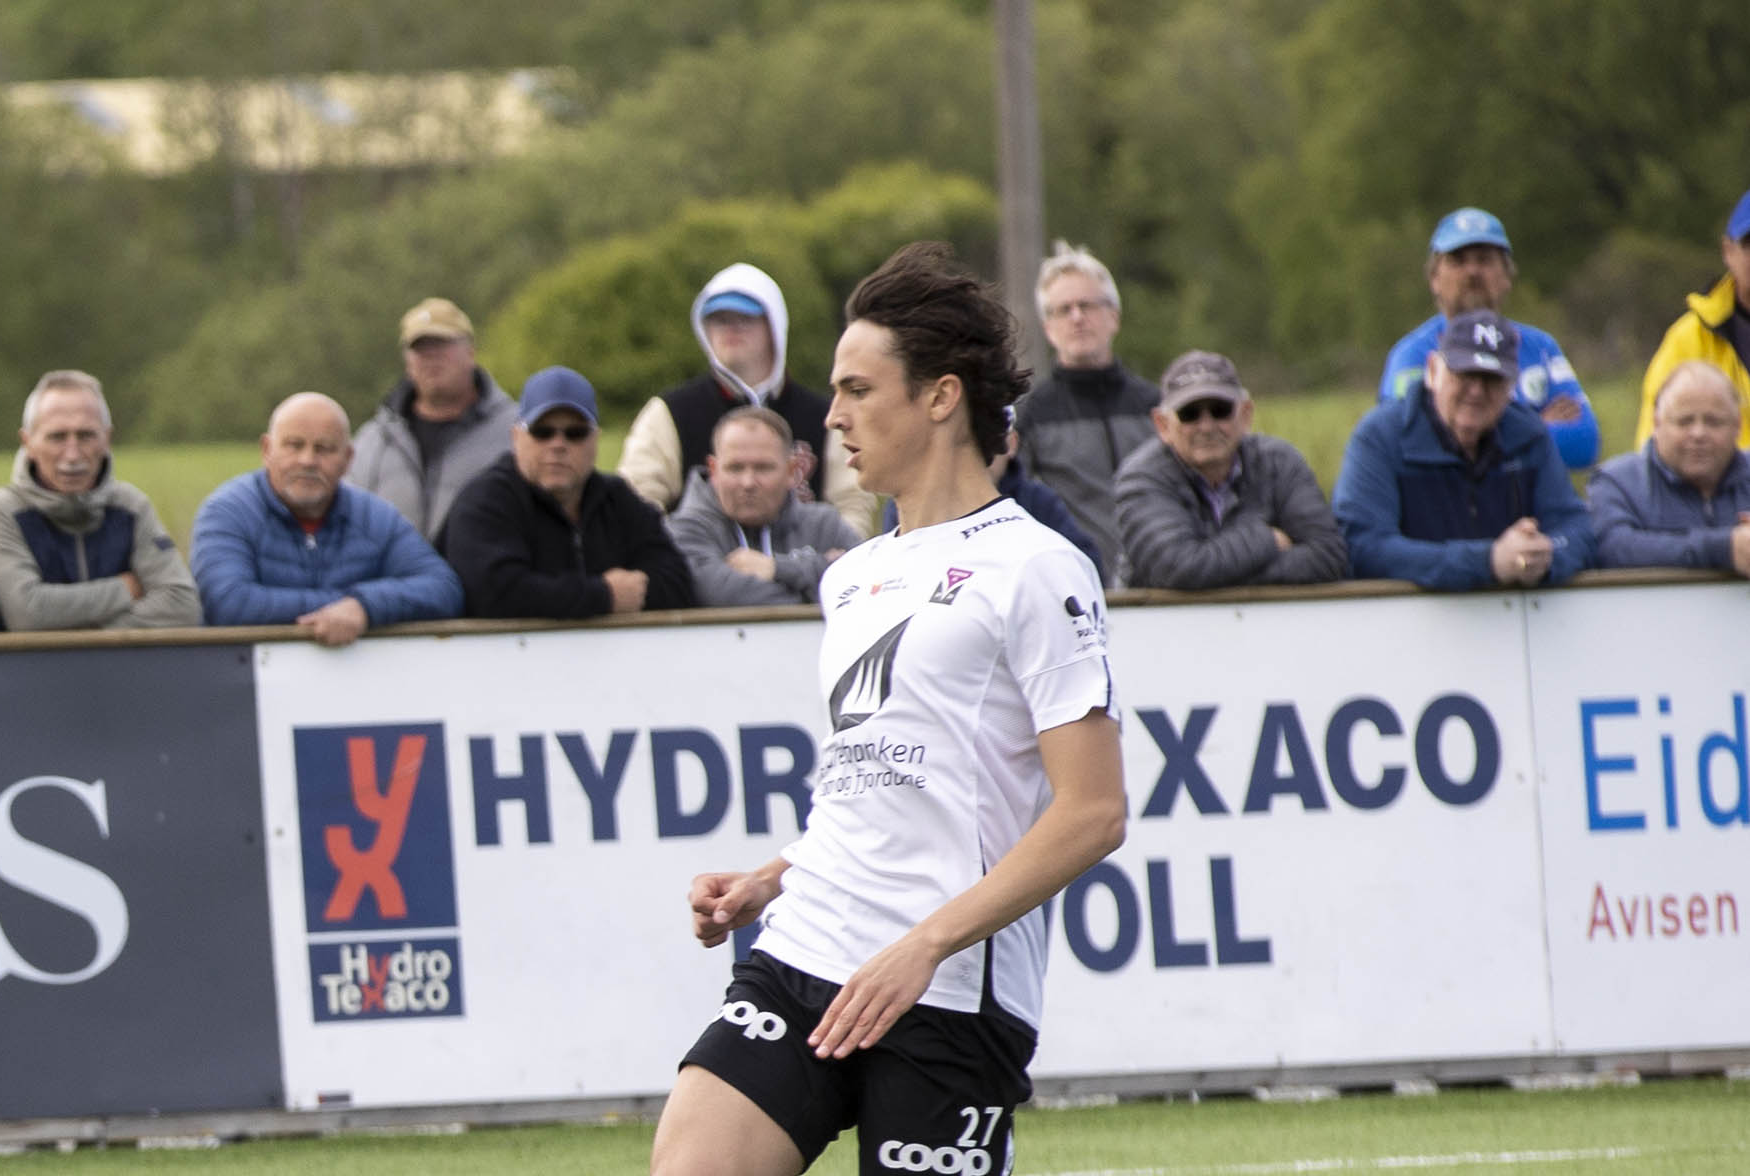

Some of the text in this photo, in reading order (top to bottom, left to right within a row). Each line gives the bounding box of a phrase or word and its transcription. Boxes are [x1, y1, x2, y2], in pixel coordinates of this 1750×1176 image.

[469, 723, 815, 847] HYDR
[1579, 692, 1750, 832] Eid
[1586, 881, 1739, 941] Avisen
[339, 941, 452, 988] Hydro
[319, 973, 450, 1015] Texaco
[957, 1106, 1003, 1148] 27
